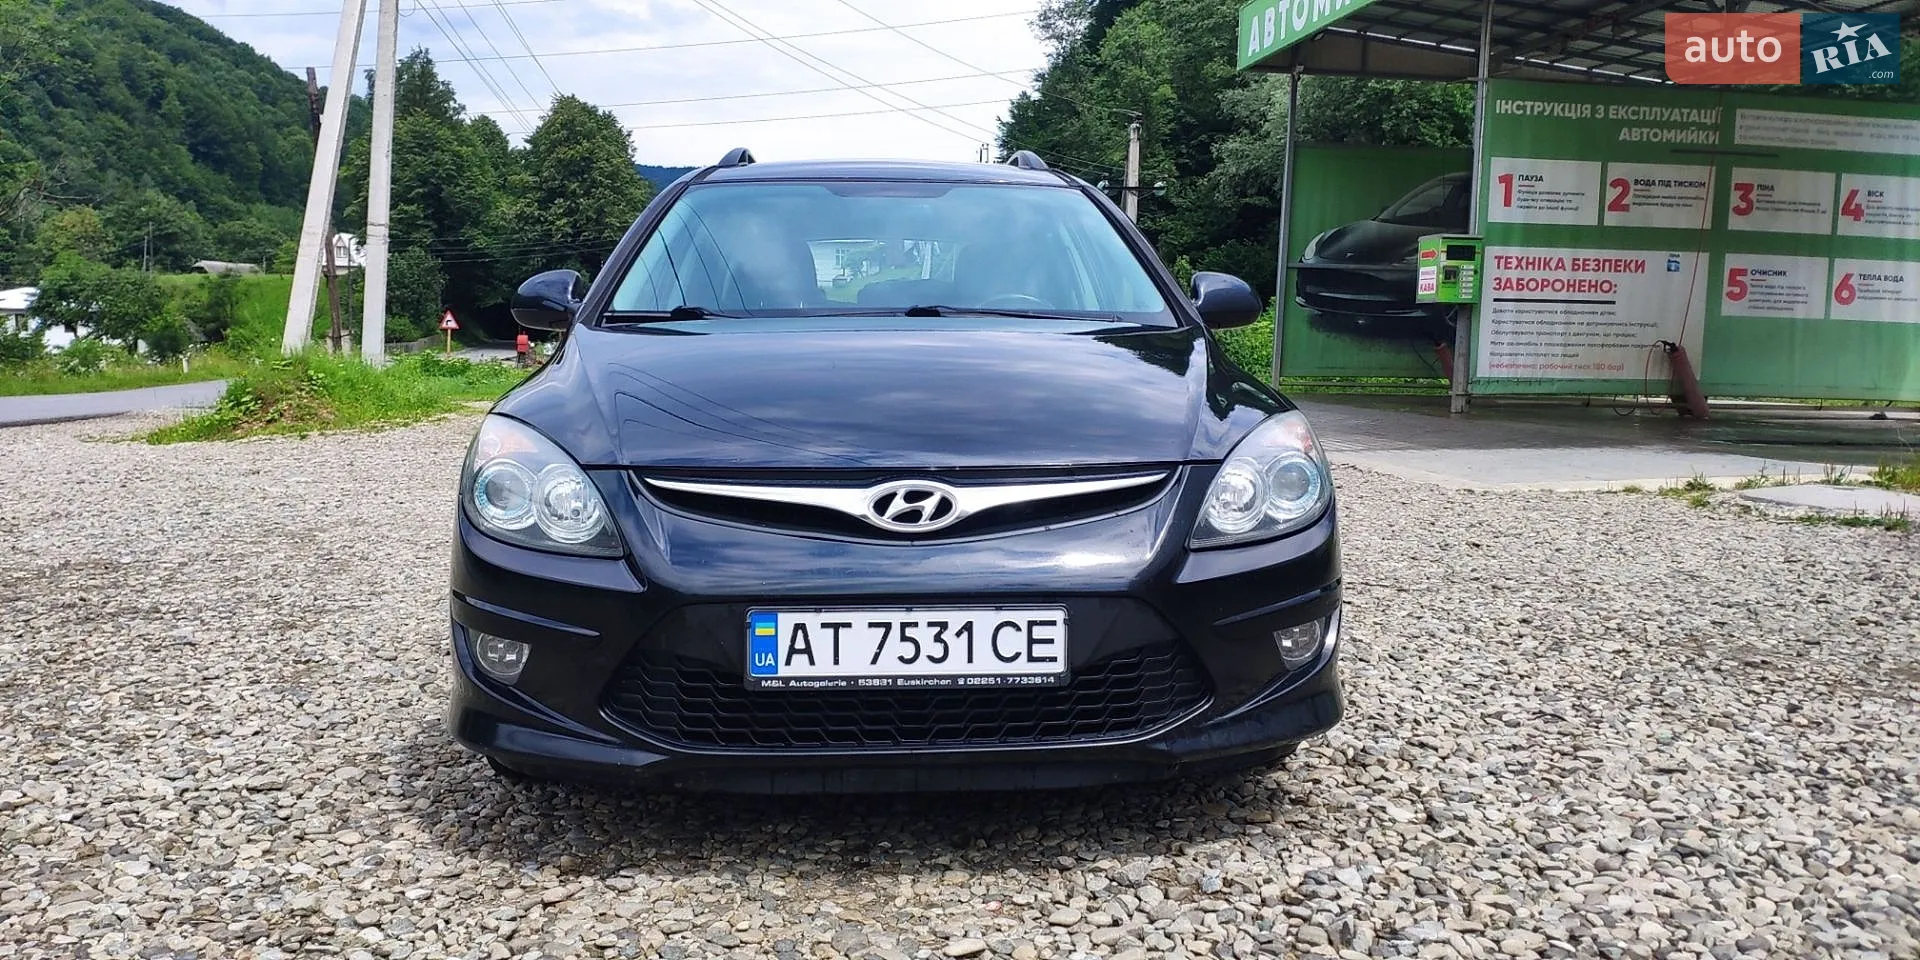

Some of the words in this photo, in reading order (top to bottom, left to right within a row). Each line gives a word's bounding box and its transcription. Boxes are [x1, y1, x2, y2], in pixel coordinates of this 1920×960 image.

[1247, 0, 1351, 57] АВТОМ
[1496, 100, 1591, 120] ІНСТРУКЦІЯ
[1595, 105, 1605, 119] З
[1609, 105, 1723, 124] ЕКСПЛУАТАЦІЇ
[1618, 126, 1719, 145] АВТОМИЙКИ
[1518, 174, 1544, 182] ПАУЗА
[1633, 178, 1657, 187] ВОДА
[1657, 179, 1671, 188] ПІД
[1673, 180, 1706, 189] ТИСКОМ
[1498, 173, 1514, 207] 1
[1607, 177, 1631, 212] 2
[1732, 182, 1755, 216] 3
[1867, 190, 1885, 198] ВІСК
[1841, 189, 1865, 221] 4
[1494, 255, 1567, 272] ТЕХНІКА
[1571, 258, 1646, 274] БЕЗПЕКИ
[1750, 268, 1788, 277] ОЧИСНИК
[1492, 277, 1618, 294] ЗАБОРОНЕНО:
[1725, 268, 1749, 302] 5
[1859, 273, 1882, 281] ТЕПЛА
[1883, 274, 1905, 283] ВОДА
[1834, 272, 1856, 305] 6
[784, 622, 853, 667] AT
[867, 620, 973, 665] 7531
[991, 620, 1058, 664] CE
[755, 652, 775, 667] UA
[897, 678, 952, 686] Euskirchen
